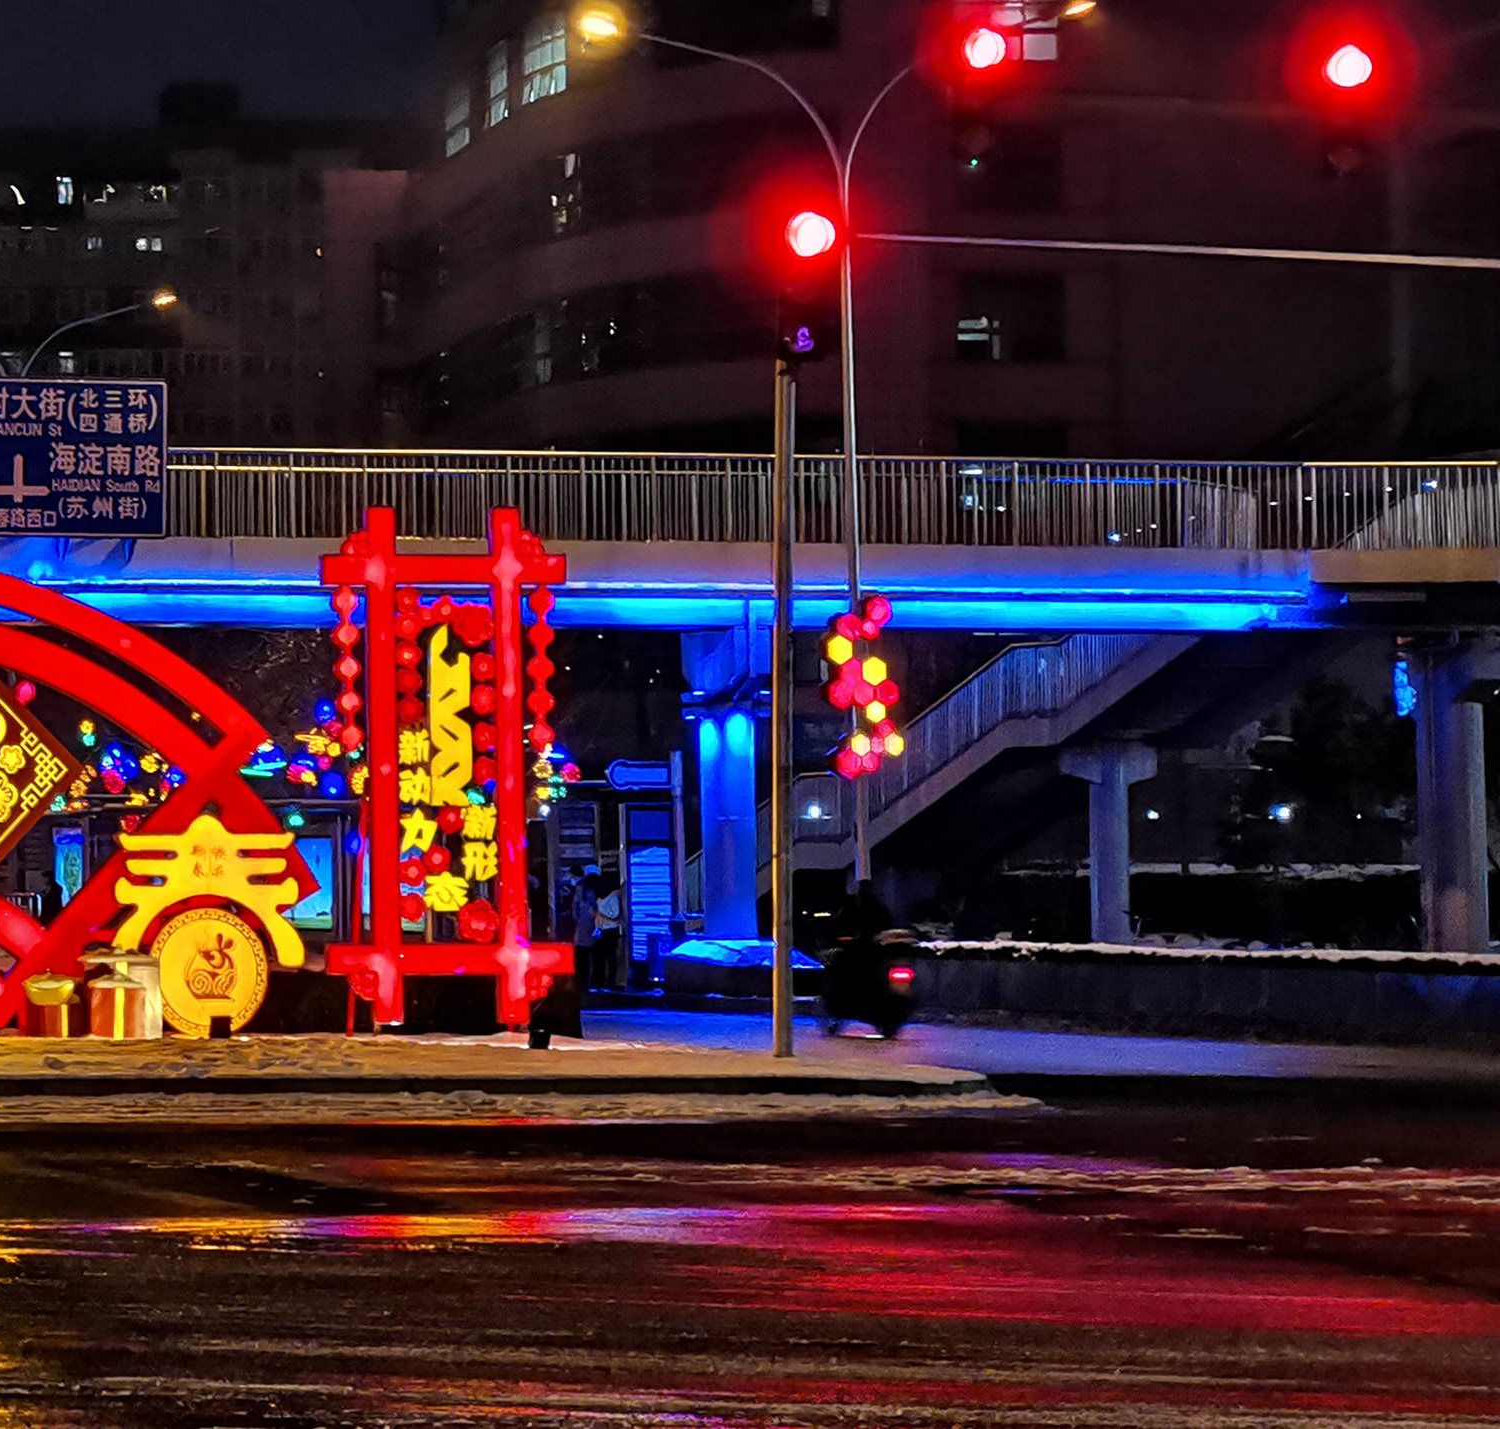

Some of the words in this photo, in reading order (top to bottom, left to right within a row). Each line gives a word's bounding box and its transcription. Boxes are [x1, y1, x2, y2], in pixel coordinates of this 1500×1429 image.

[48, 423, 63, 437] St
[49, 441, 161, 477] 海淀南路
[51, 478, 101, 492] HAIDIAN
[106, 479, 140, 492] South
[145, 479, 161, 493] Rd
[398, 729, 438, 853] 新动力
